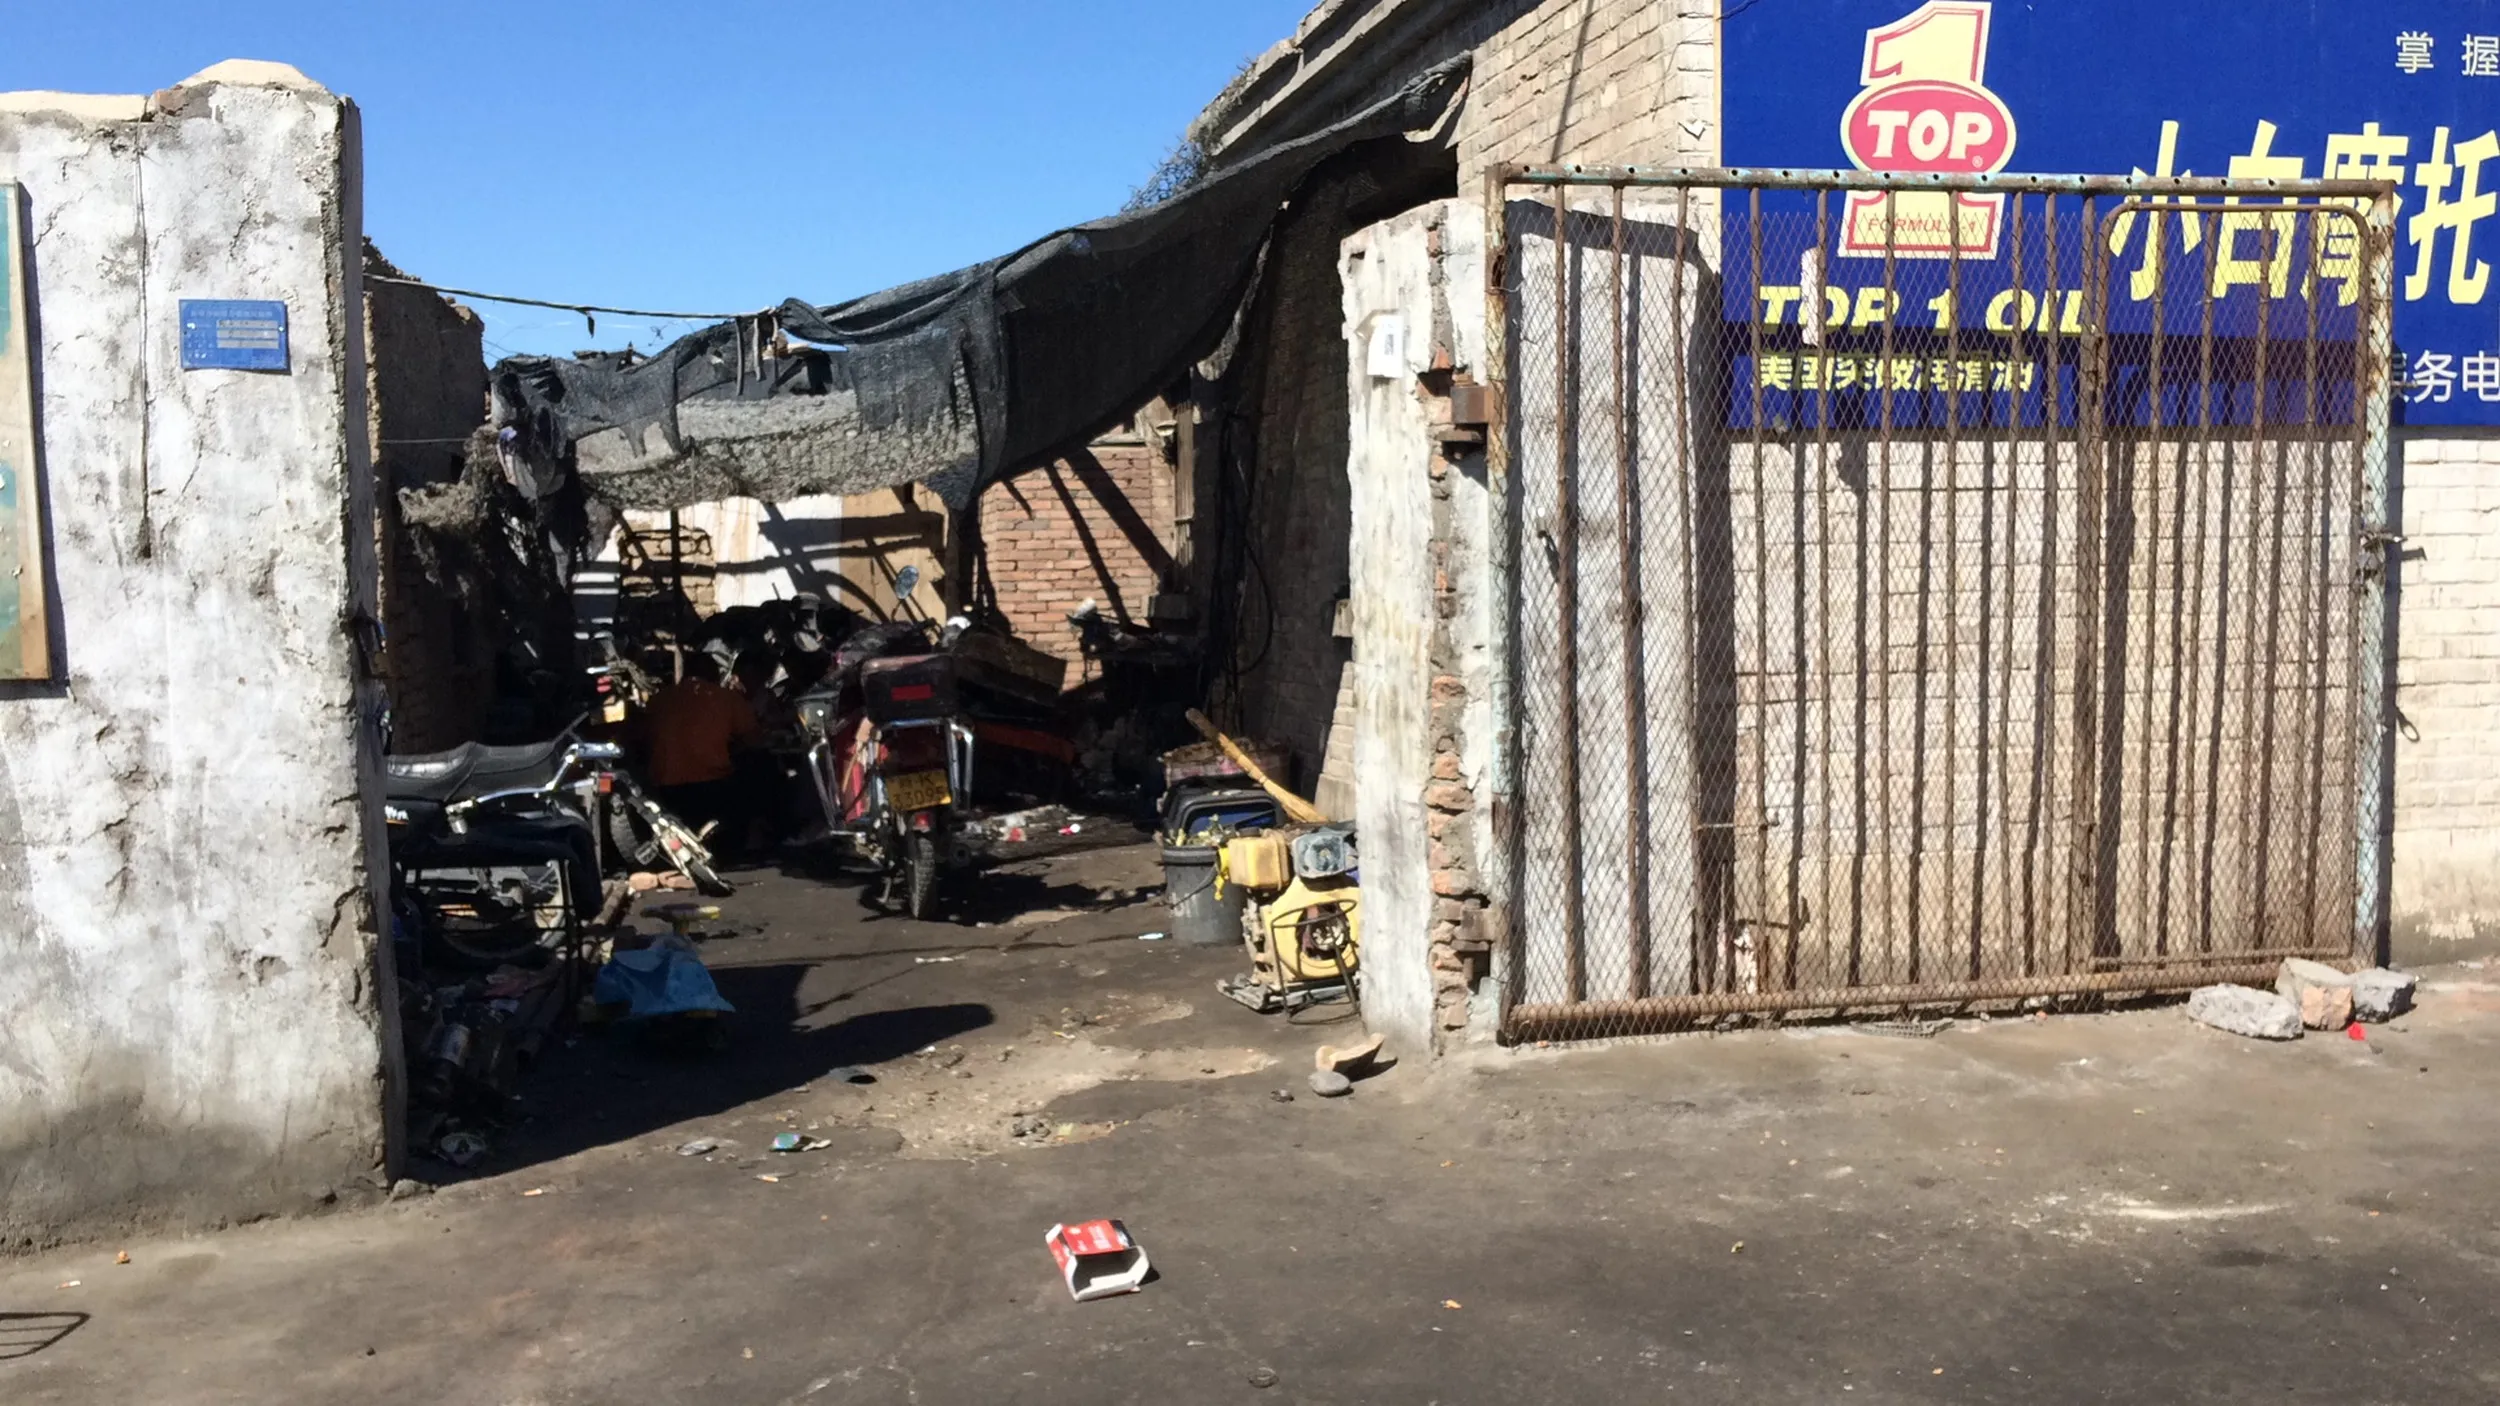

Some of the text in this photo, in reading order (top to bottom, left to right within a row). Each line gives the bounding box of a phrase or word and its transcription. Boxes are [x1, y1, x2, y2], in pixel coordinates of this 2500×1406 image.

[1867, 109, 1993, 161] TOP
[1867, 217, 1977, 234] FORMUL-1
[1759, 286, 1901, 334] TOP
